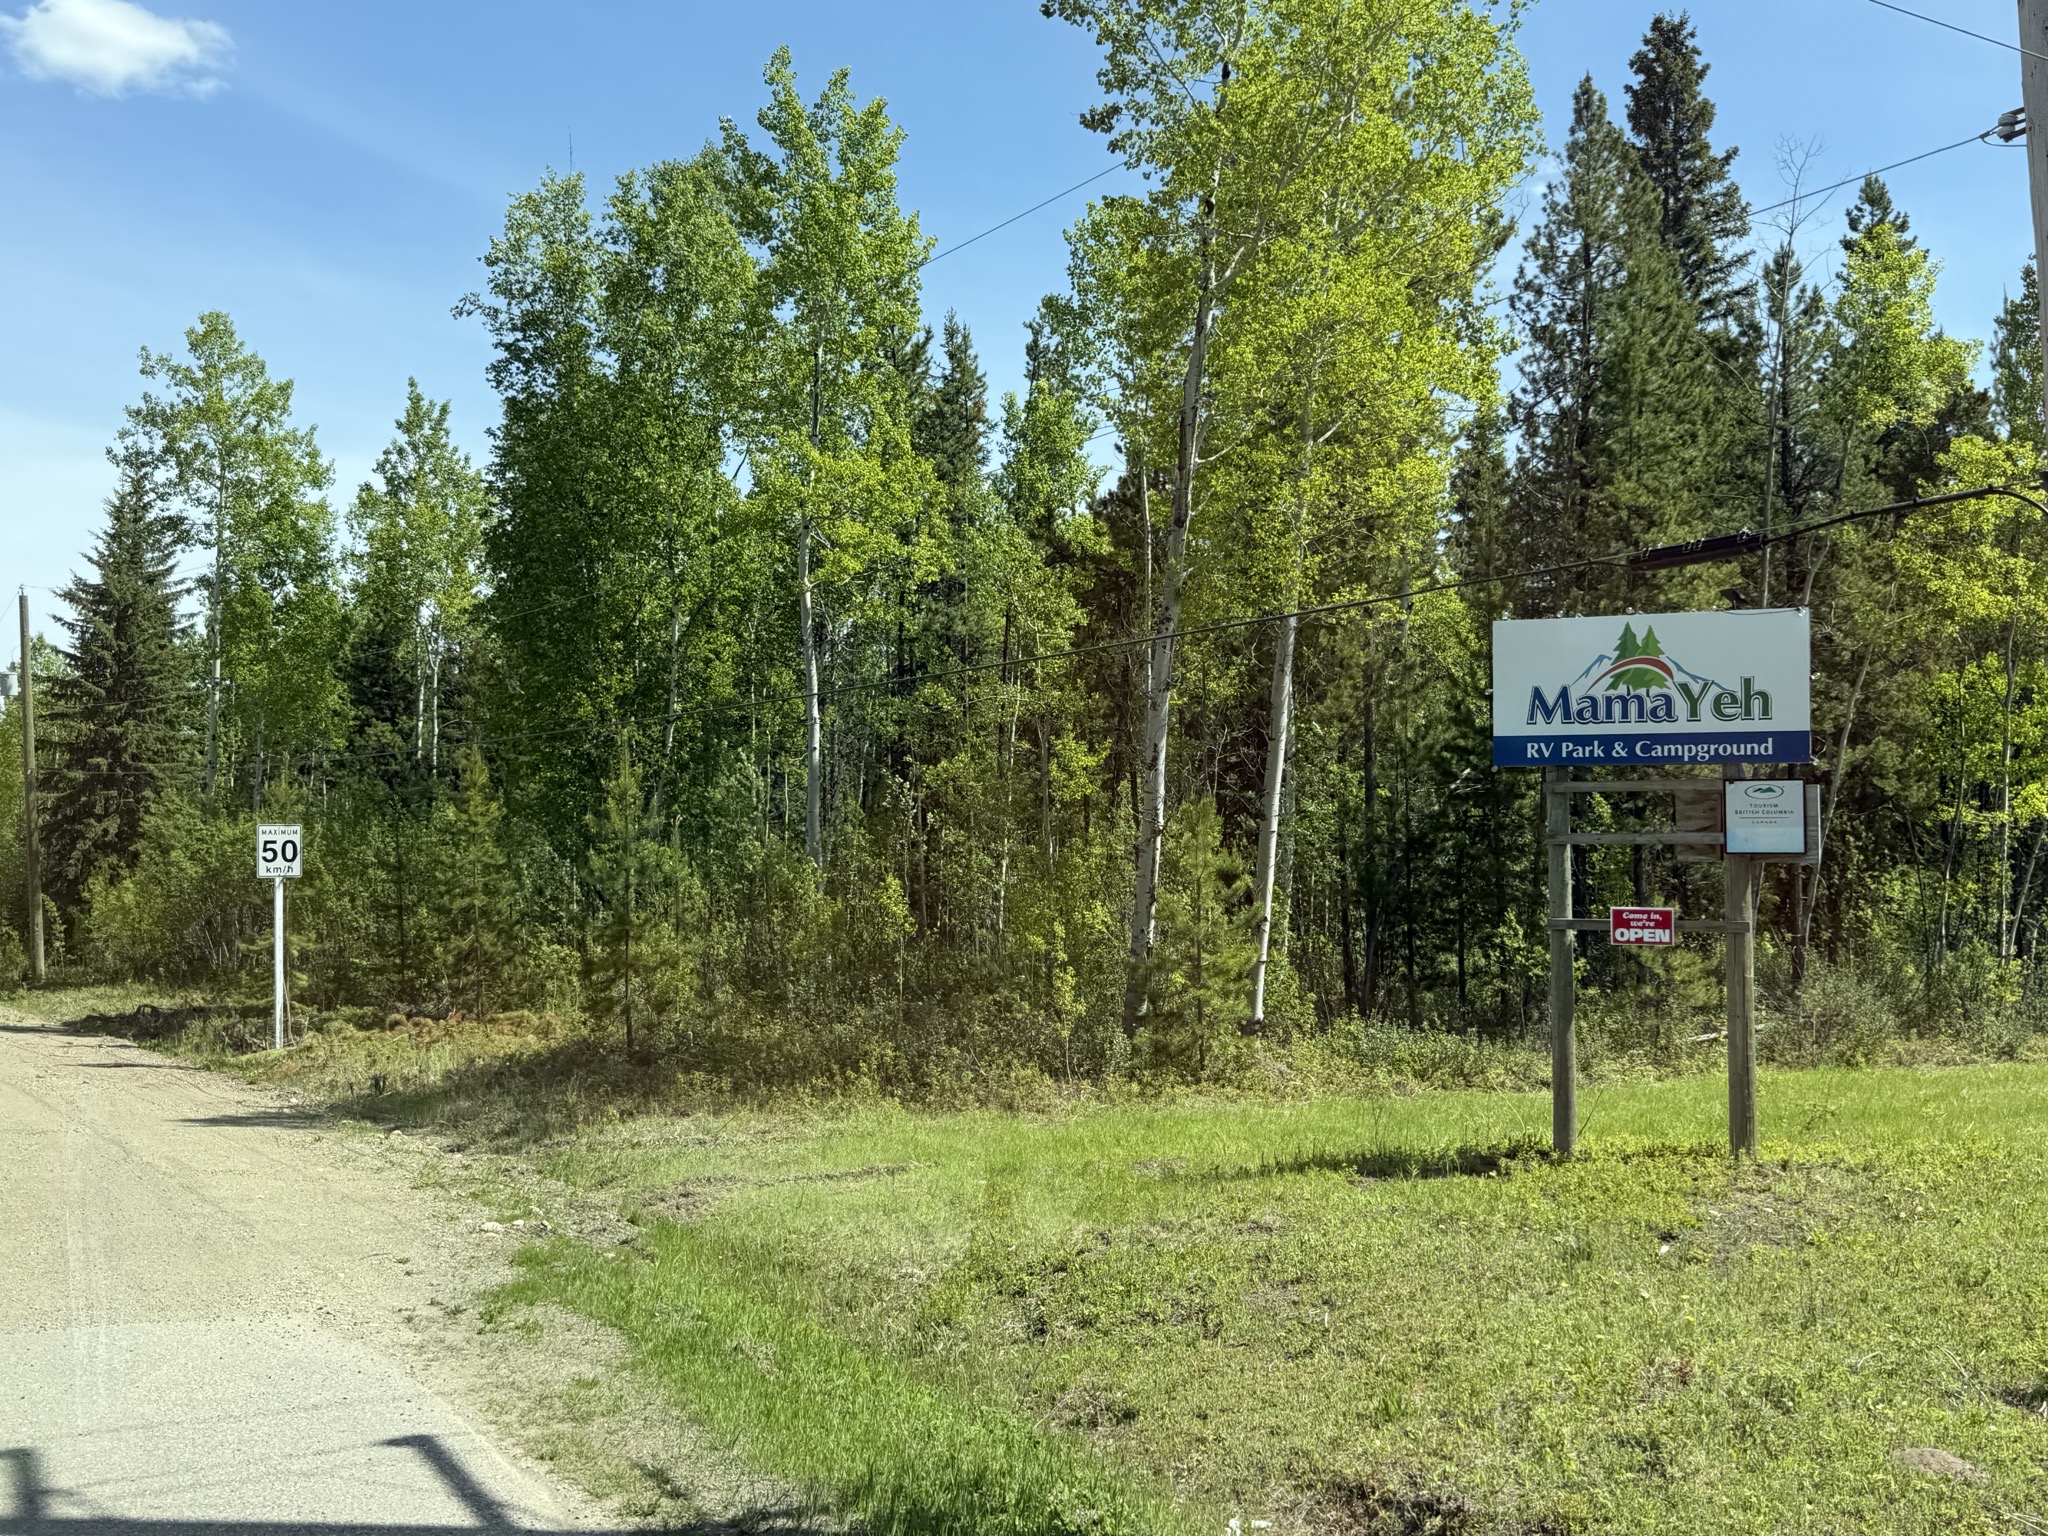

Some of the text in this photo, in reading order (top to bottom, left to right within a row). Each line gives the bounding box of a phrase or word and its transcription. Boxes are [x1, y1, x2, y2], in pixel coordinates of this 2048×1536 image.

[1526, 738, 1773, 761] RV Park & Campground
[261, 839, 298, 863] 50
[265, 865, 294, 873] km/h
[1650, 912, 1662, 920] in,
[1614, 927, 1671, 942] OPEN
